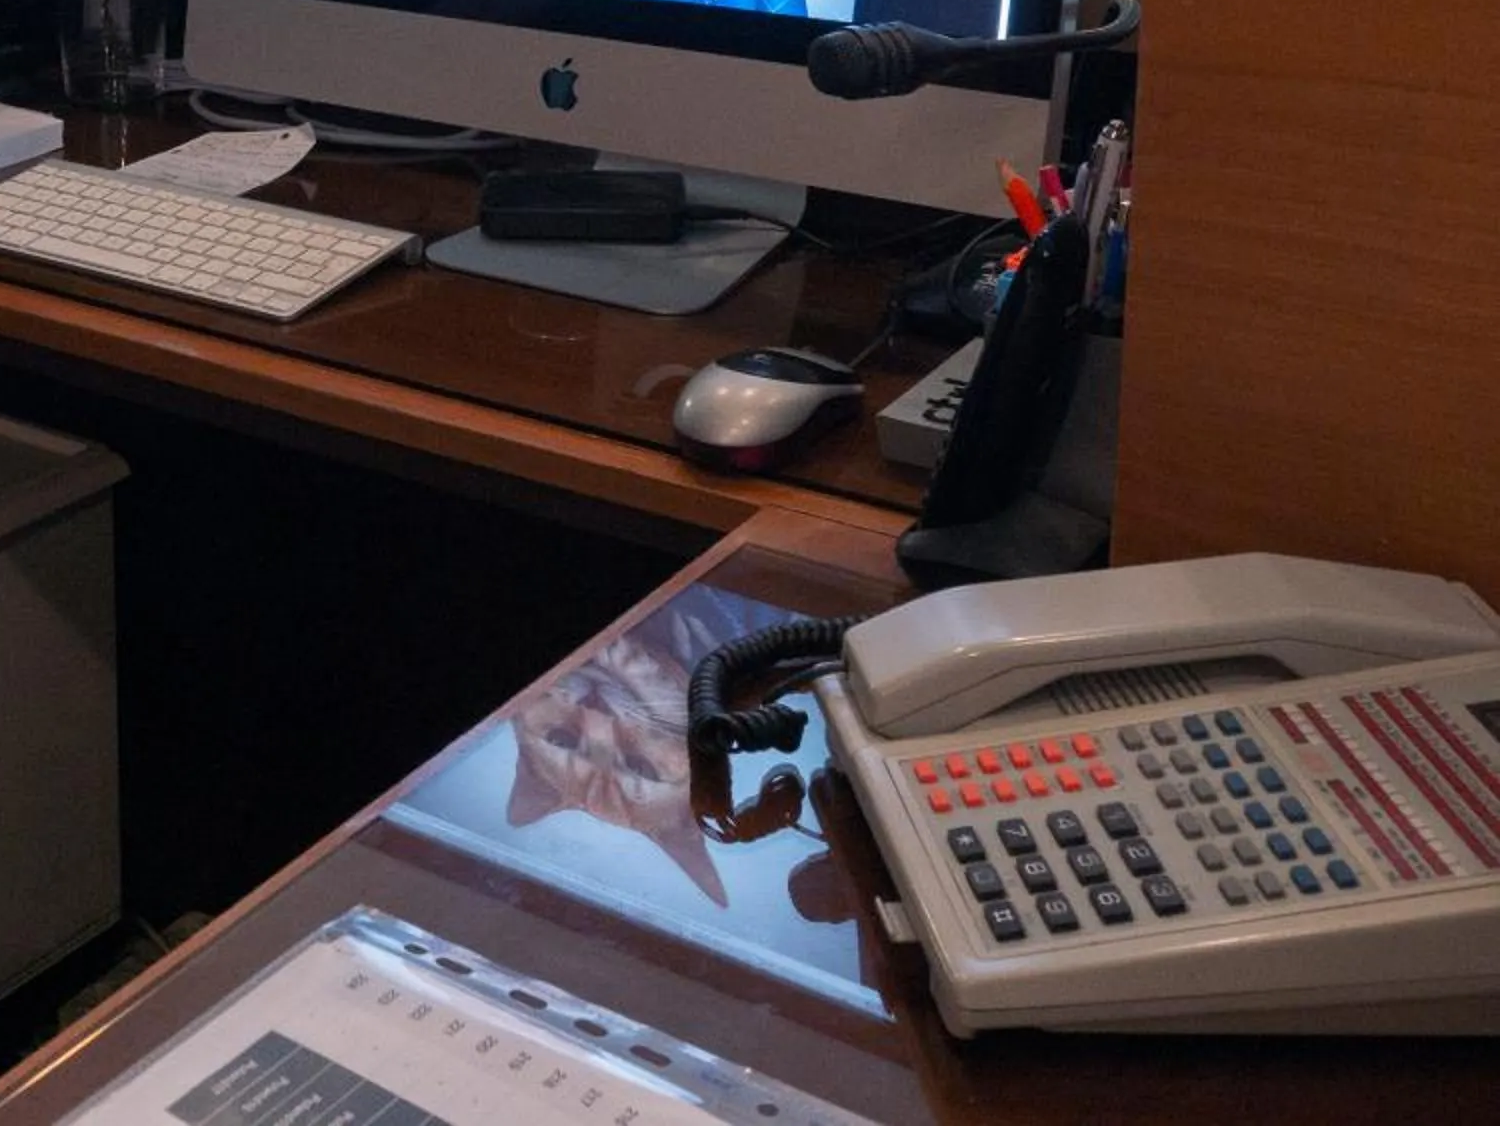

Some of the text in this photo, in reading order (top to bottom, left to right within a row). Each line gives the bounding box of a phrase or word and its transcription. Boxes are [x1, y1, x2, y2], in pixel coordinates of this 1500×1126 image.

[1005, 825, 1028, 837] 7
[1057, 816, 1075, 830] 4
[1024, 845, 1150, 875] 8 5 2
[1045, 900, 1068, 914] 9
[1097, 892, 1121, 906] 6
[1150, 882, 1175, 897] 3
[580, 1087, 603, 1109] 217
